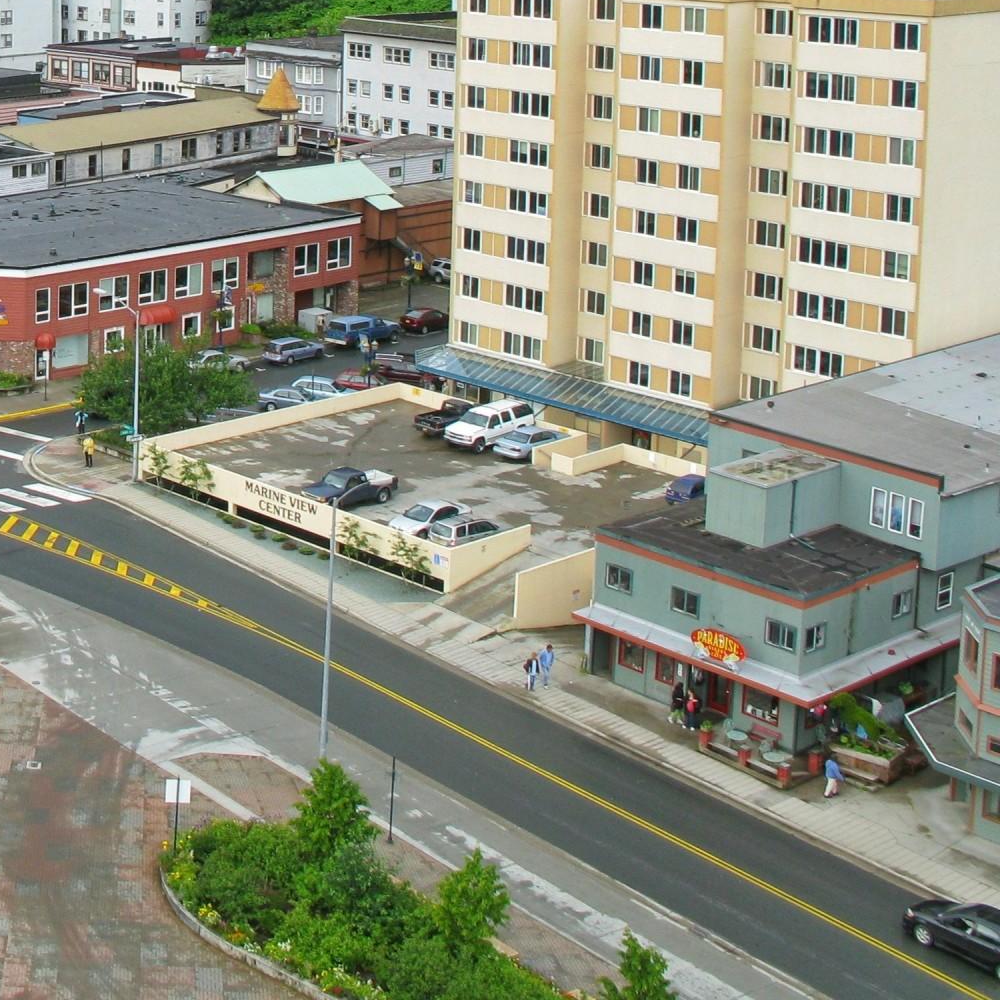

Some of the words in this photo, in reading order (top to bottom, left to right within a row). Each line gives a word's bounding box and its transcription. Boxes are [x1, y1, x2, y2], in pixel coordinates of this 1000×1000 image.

[245, 481, 287, 505] MARINE
[289, 496, 318, 515] VIEW
[258, 500, 302, 523] CENTER
[697, 631, 740, 655] PARADISE
